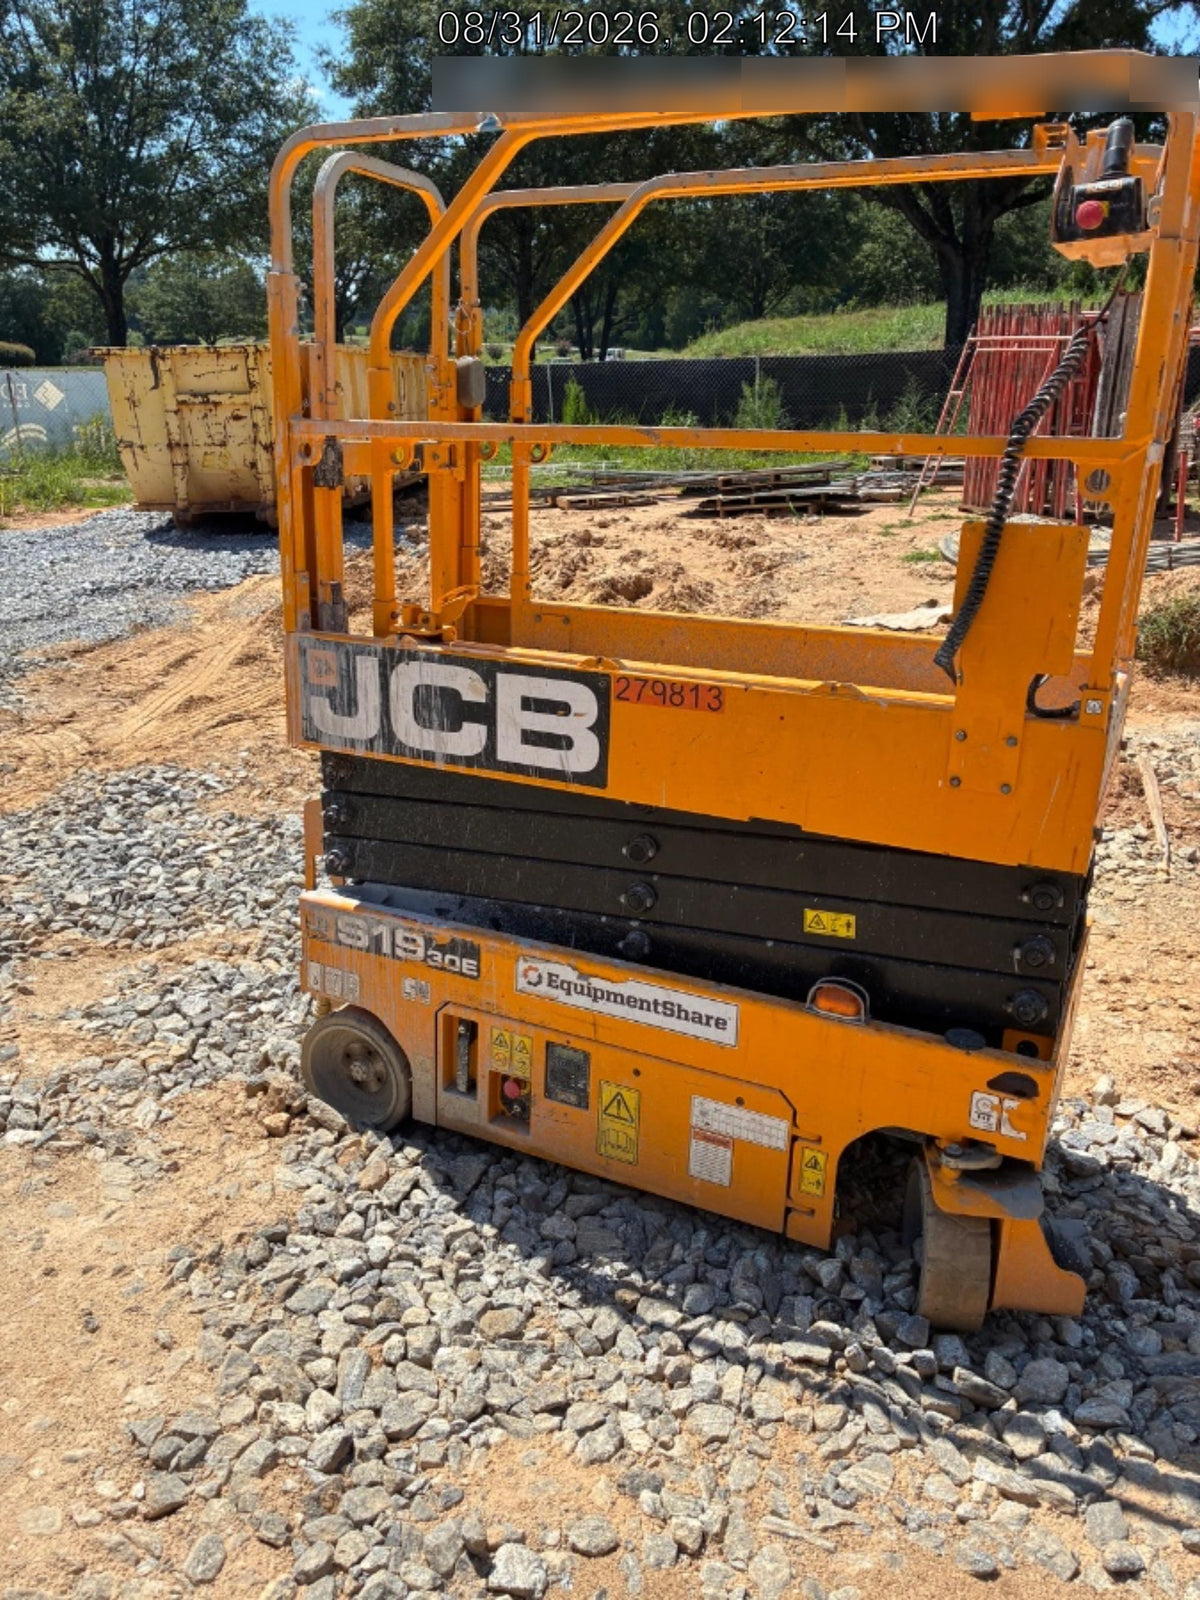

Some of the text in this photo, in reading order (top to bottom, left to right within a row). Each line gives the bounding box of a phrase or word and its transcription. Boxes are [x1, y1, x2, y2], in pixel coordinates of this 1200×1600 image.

[310, 655, 600, 773] JCB
[615, 676, 722, 712] 279813
[546, 971, 728, 1031] EquipmentShare
